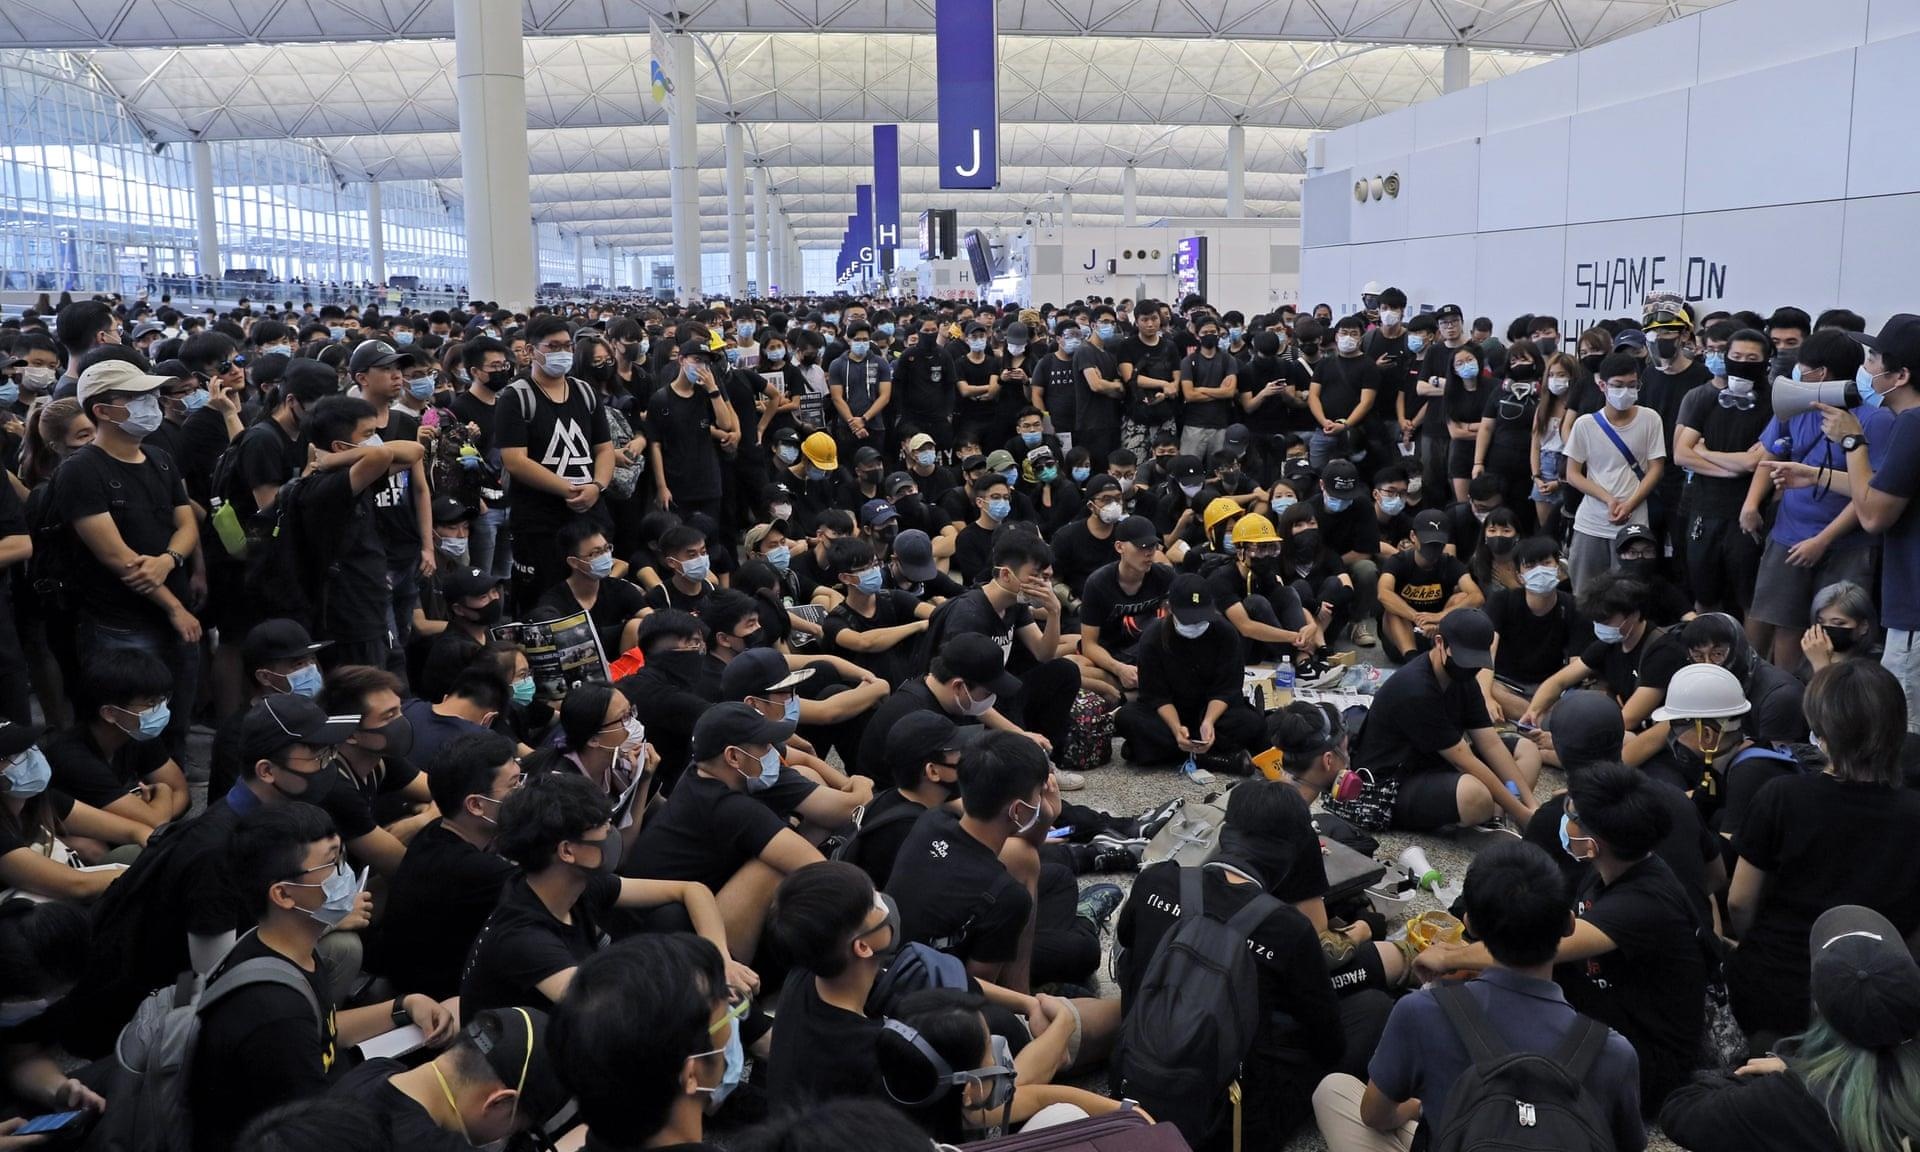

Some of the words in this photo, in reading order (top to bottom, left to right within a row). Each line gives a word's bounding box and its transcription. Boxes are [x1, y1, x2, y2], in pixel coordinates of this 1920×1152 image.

[955, 129, 980, 176] J
[880, 224, 896, 245] H
[860, 247, 873, 261] G
[1083, 249, 1096, 270] J
[851, 261, 859, 272] F
[960, 271, 968, 282] H
[1575, 256, 1666, 311] SHAME
[1685, 256, 1727, 301] ON
[1403, 586, 1441, 598] Dickies
[1146, 893, 1181, 917] flesh
